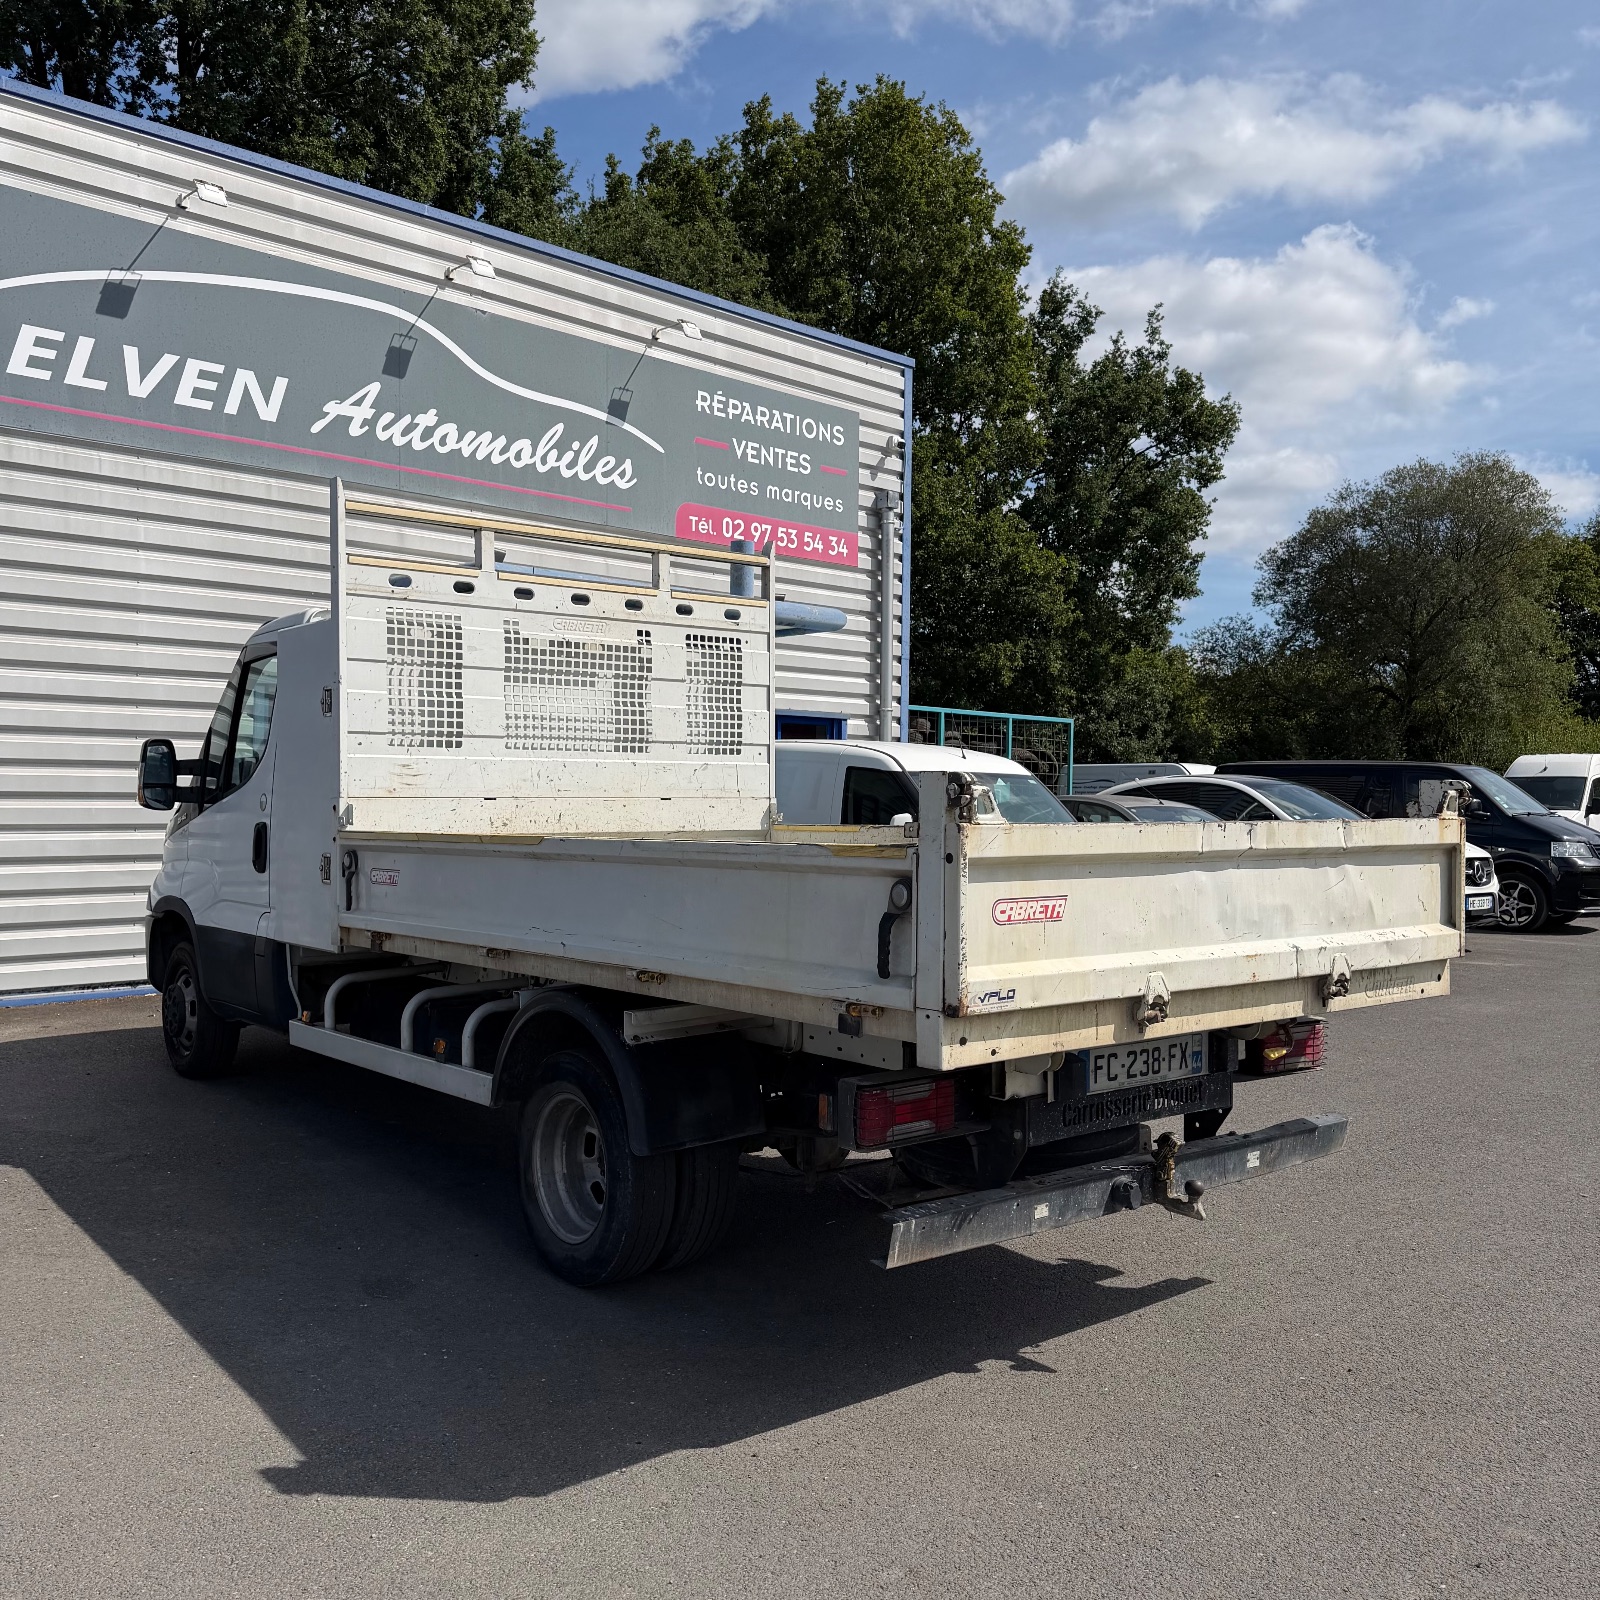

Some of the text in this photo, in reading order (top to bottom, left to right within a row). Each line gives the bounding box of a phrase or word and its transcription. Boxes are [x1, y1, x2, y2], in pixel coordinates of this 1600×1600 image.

[6, 323, 637, 489] ELVEN Automobiles
[695, 389, 845, 446] RÉPARATIONS
[732, 437, 812, 475] VENTES
[696, 466, 844, 513] toutes marques
[688, 515, 848, 558] Tél. 02 97 53 54 34
[994, 899, 1066, 921] CABRETA
[1062, 1092, 1151, 1127] Carrosserie
